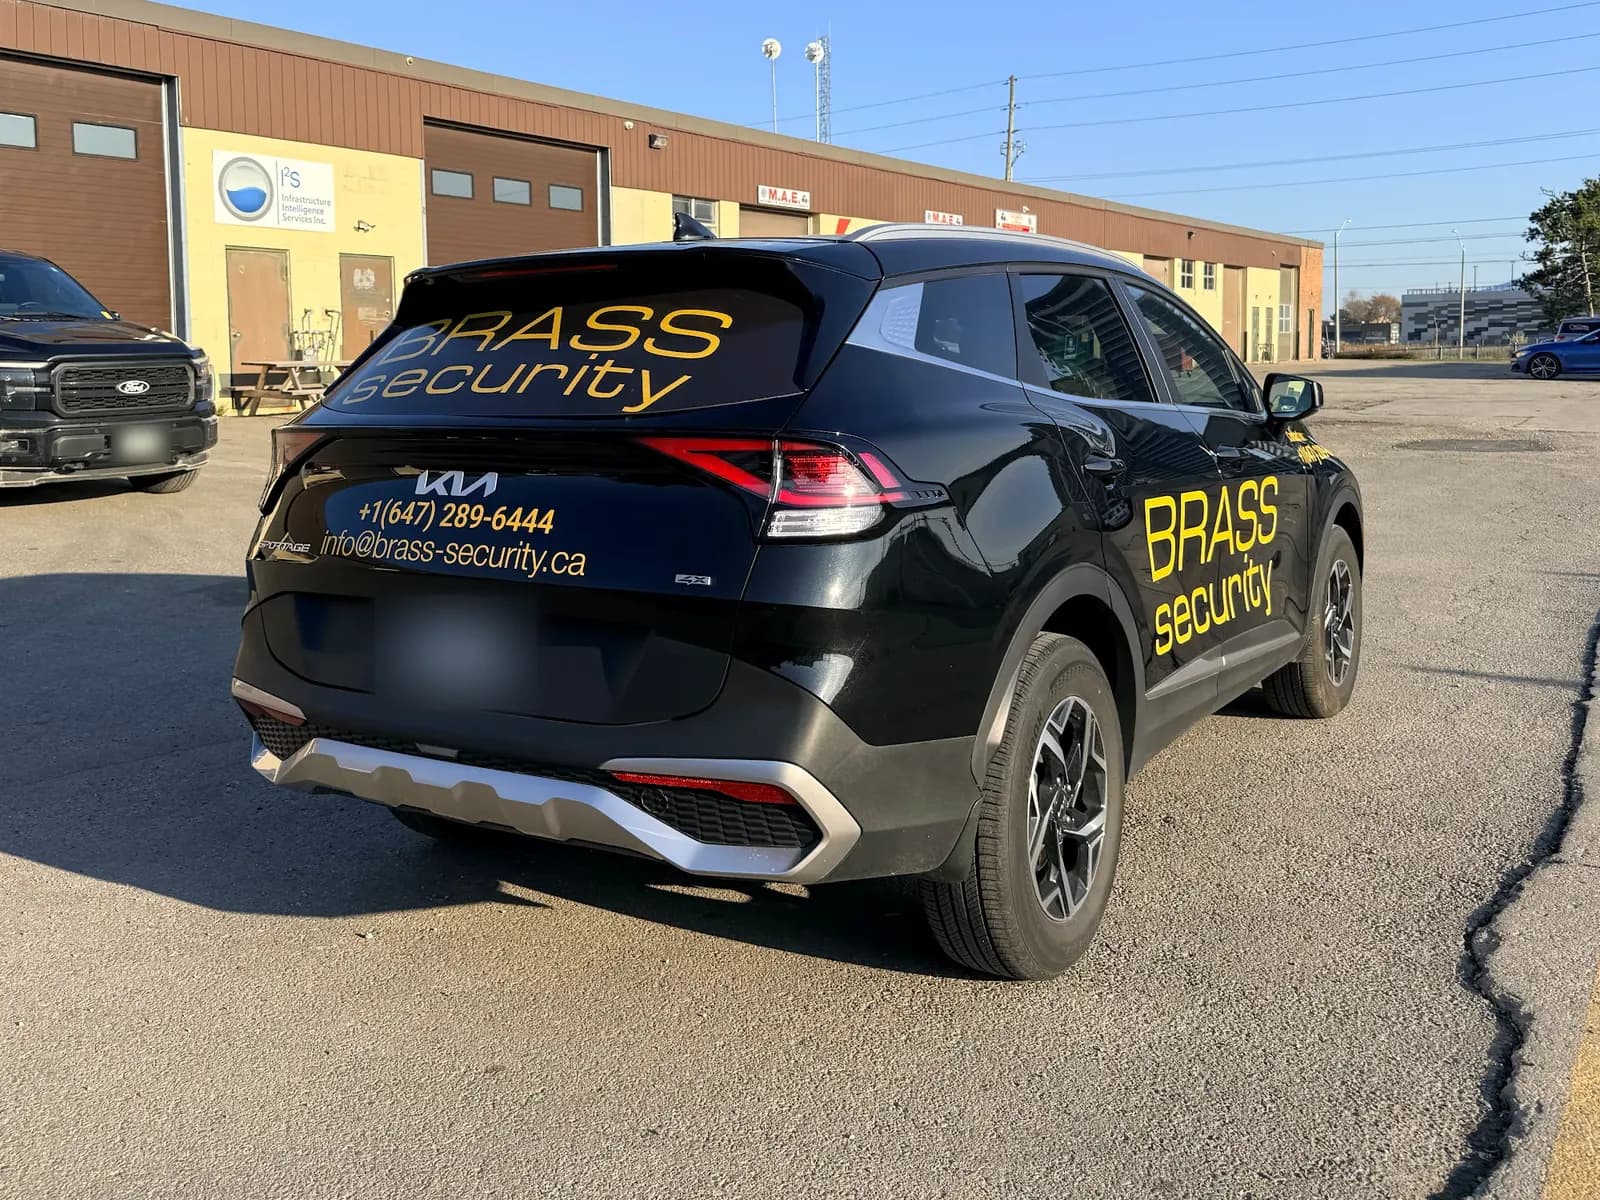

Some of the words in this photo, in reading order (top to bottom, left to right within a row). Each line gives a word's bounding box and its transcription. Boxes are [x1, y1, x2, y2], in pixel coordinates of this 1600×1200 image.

[281, 194, 332, 207] Infrastructure
[281, 203, 325, 215] Intelligence
[282, 212, 313, 224] Services
[313, 216, 327, 225] Inc.
[376, 305, 734, 366] BRASS
[342, 352, 693, 413] security
[359, 499, 437, 532] +1(647)
[439, 502, 556, 535] 289-6444
[1144, 475, 1279, 583] BRASS
[320, 529, 587, 578] info@brass-security.ca
[1154, 553, 1273, 656] security
